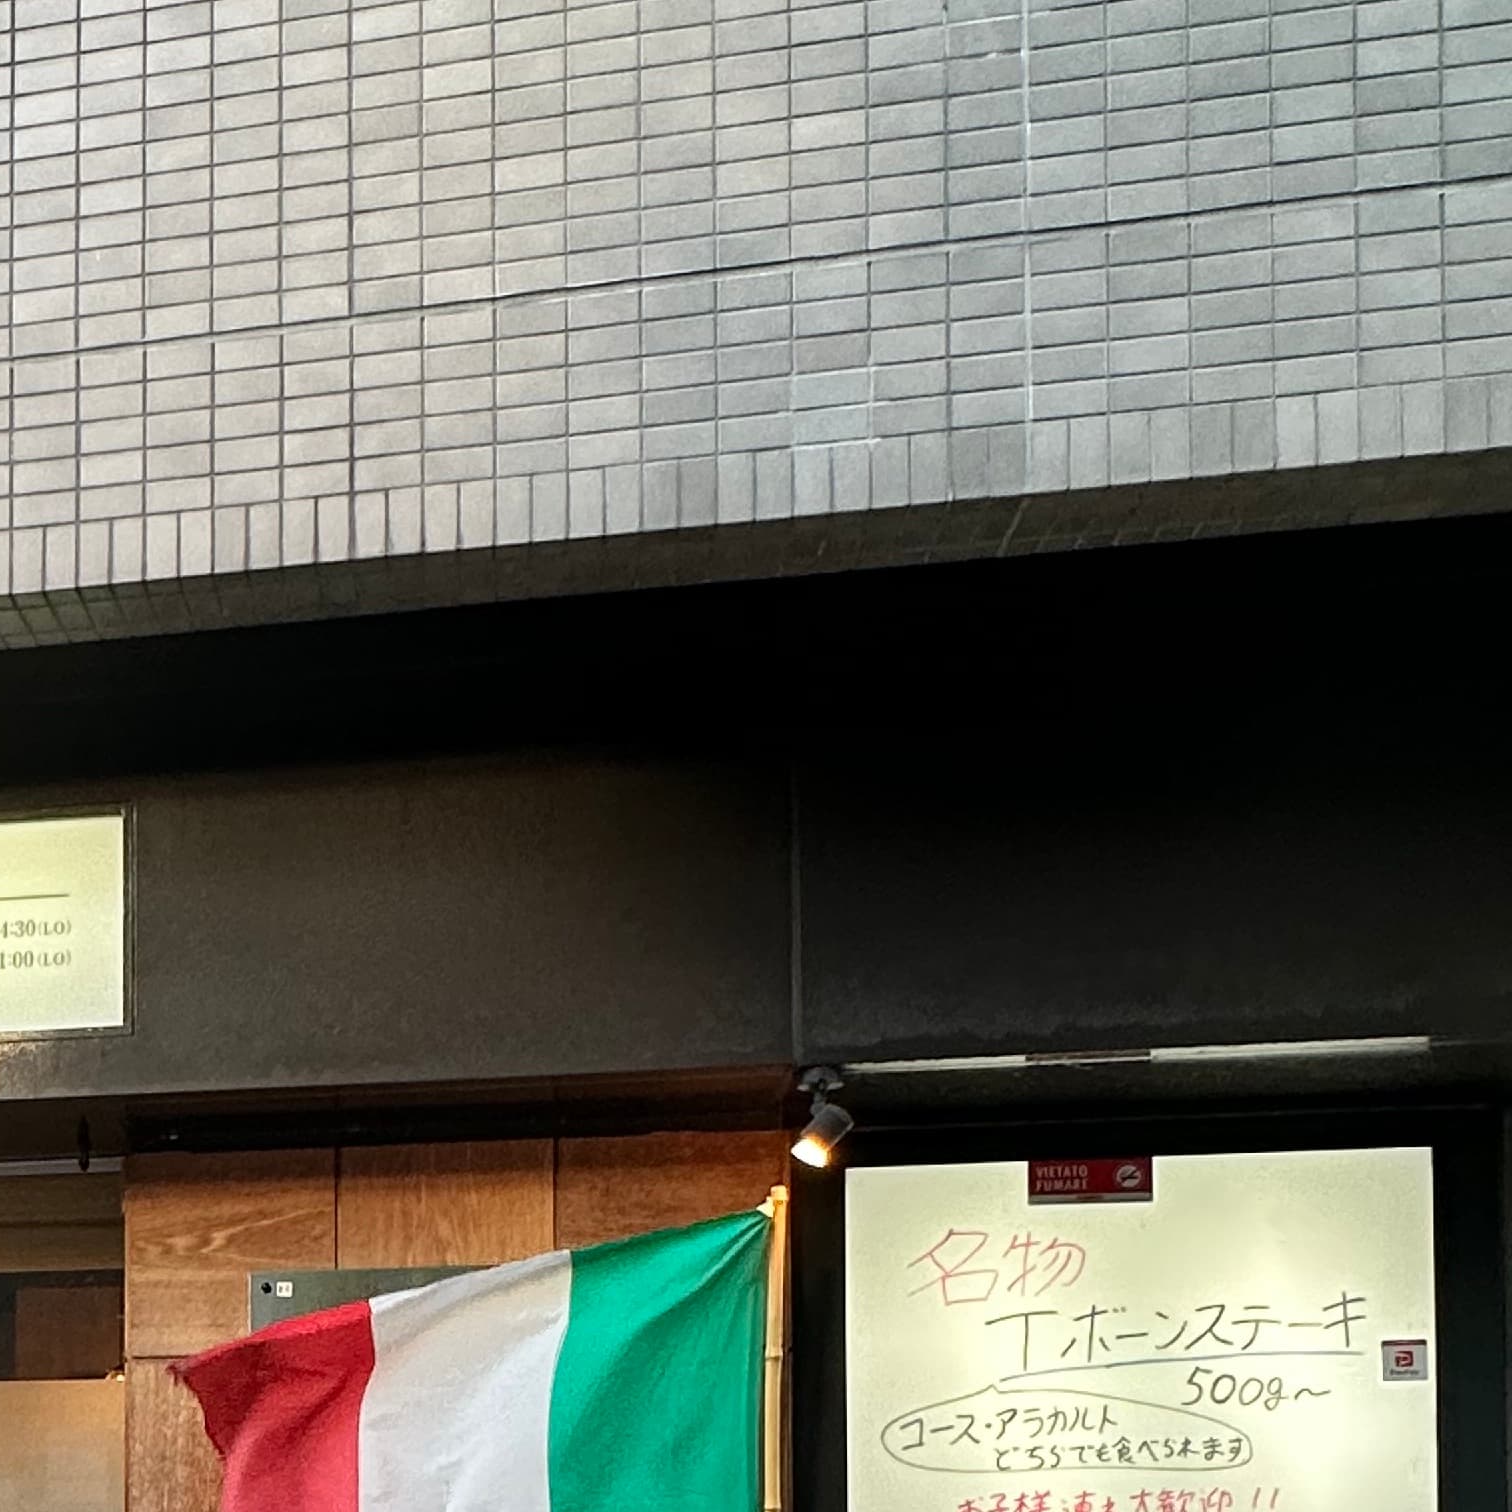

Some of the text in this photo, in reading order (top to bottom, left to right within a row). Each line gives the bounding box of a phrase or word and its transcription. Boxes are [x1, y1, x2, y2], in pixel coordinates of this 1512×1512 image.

[1035, 1164, 1089, 1178] VIETATO
[906, 1228, 1086, 1306] 名物
[899, 1404, 1118, 1453] コース・アラカルト
[993, 1436, 1245, 1471] どちらでも食べられます
